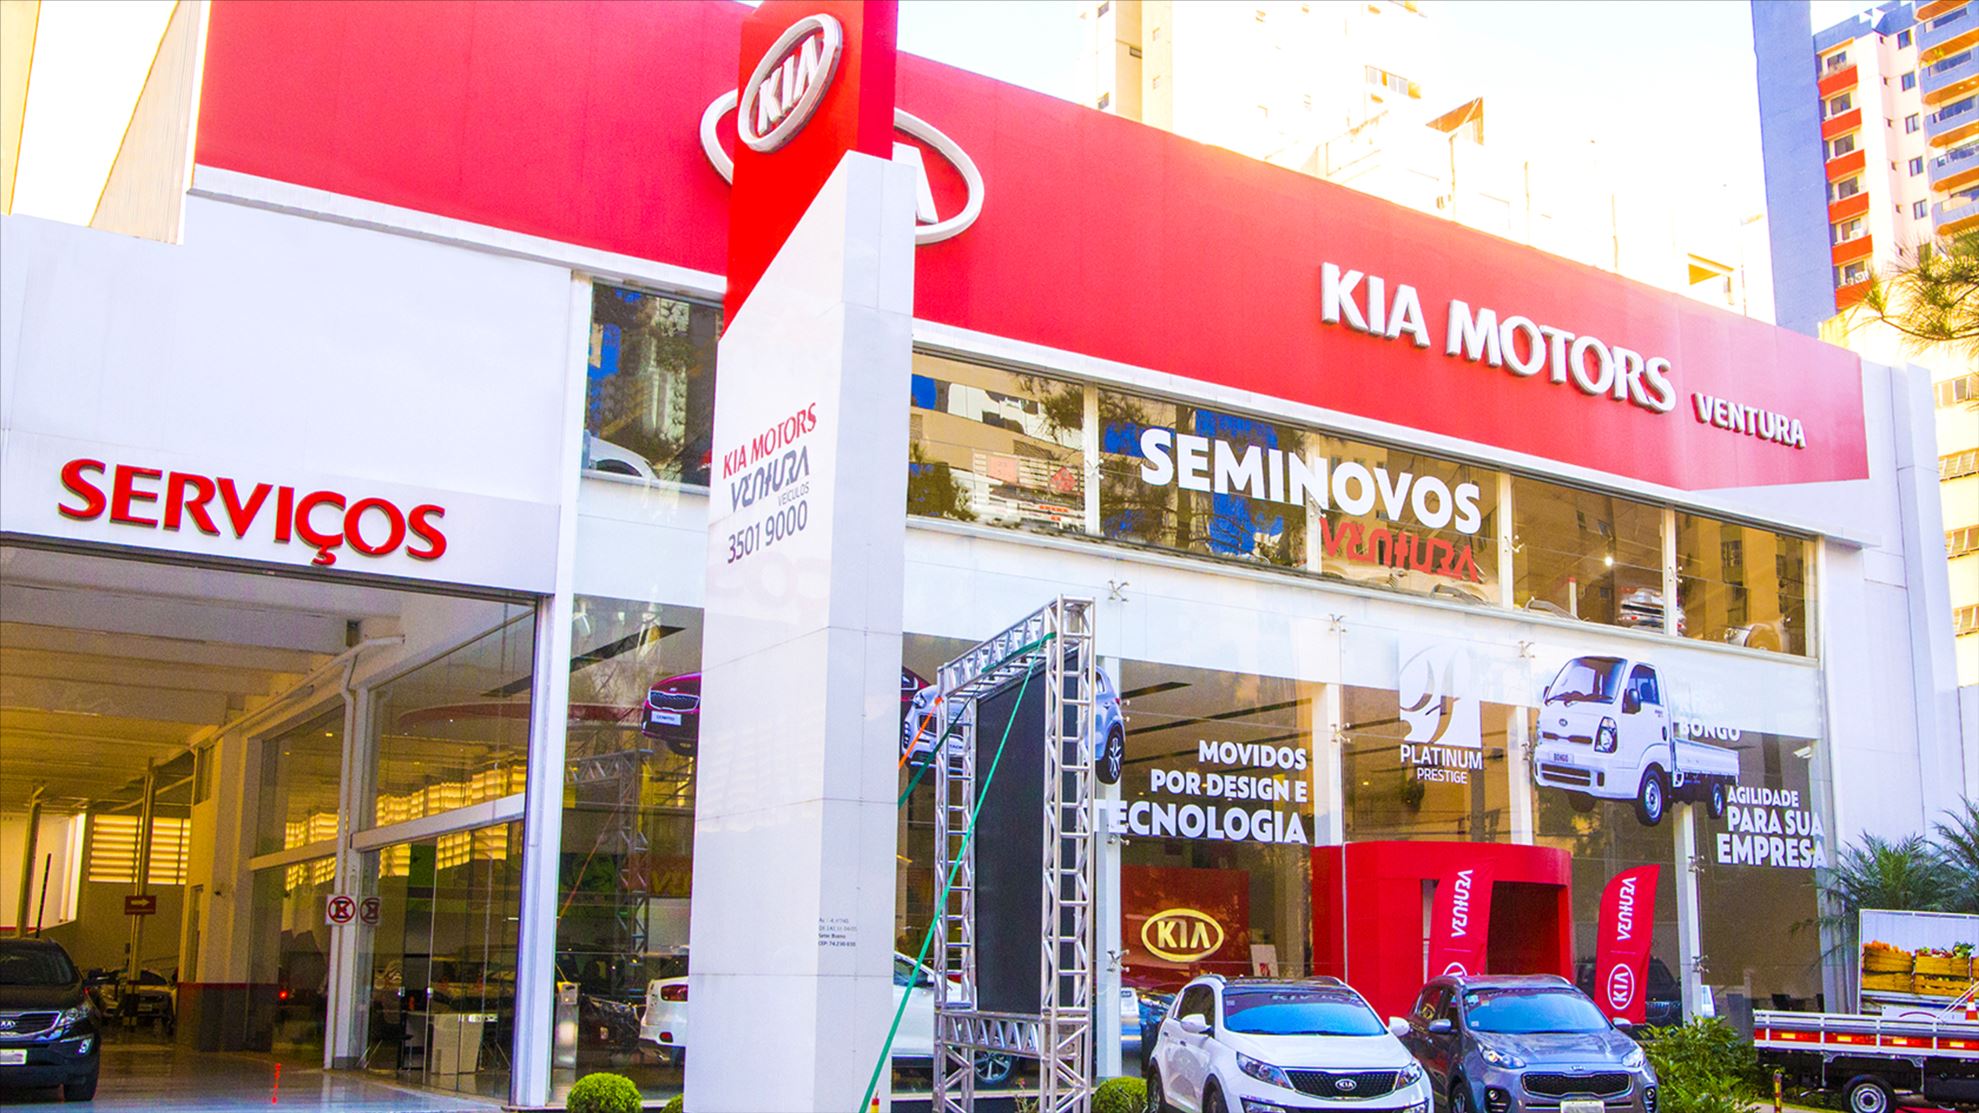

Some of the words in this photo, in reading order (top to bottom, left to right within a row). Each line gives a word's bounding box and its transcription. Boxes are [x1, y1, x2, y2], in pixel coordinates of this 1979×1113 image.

[757, 35, 821, 135] KIA
[1320, 262, 1430, 348] KIA
[1445, 299, 1677, 414] MOTORS
[1694, 391, 1807, 450] VENTURA
[723, 445, 747, 480] KIA
[751, 402, 817, 465] MOTORS
[1140, 428, 1482, 534] SEMINOVOS
[58, 458, 448, 567] SERVIÇOS
[728, 522, 760, 564] 3501
[765, 500, 808, 546] 9000
[1679, 717, 1741, 742] BONGO
[1199, 740, 1307, 771] MOVIDOS
[1400, 744, 1483, 770] PLATINUM
[1150, 768, 1201, 796] POR
[1207, 774, 1289, 801] DESIGN
[1295, 780, 1307, 802] E
[1417, 767, 1468, 784] PRESTIGE
[1727, 786, 1799, 807] AGILIDADE
[1727, 806, 1783, 835] PARA
[1785, 810, 1825, 837] SUA
[1717, 833, 1828, 868] EMPRESA
[1157, 920, 1211, 949] KIA
[1612, 970, 1629, 1003] KIA
